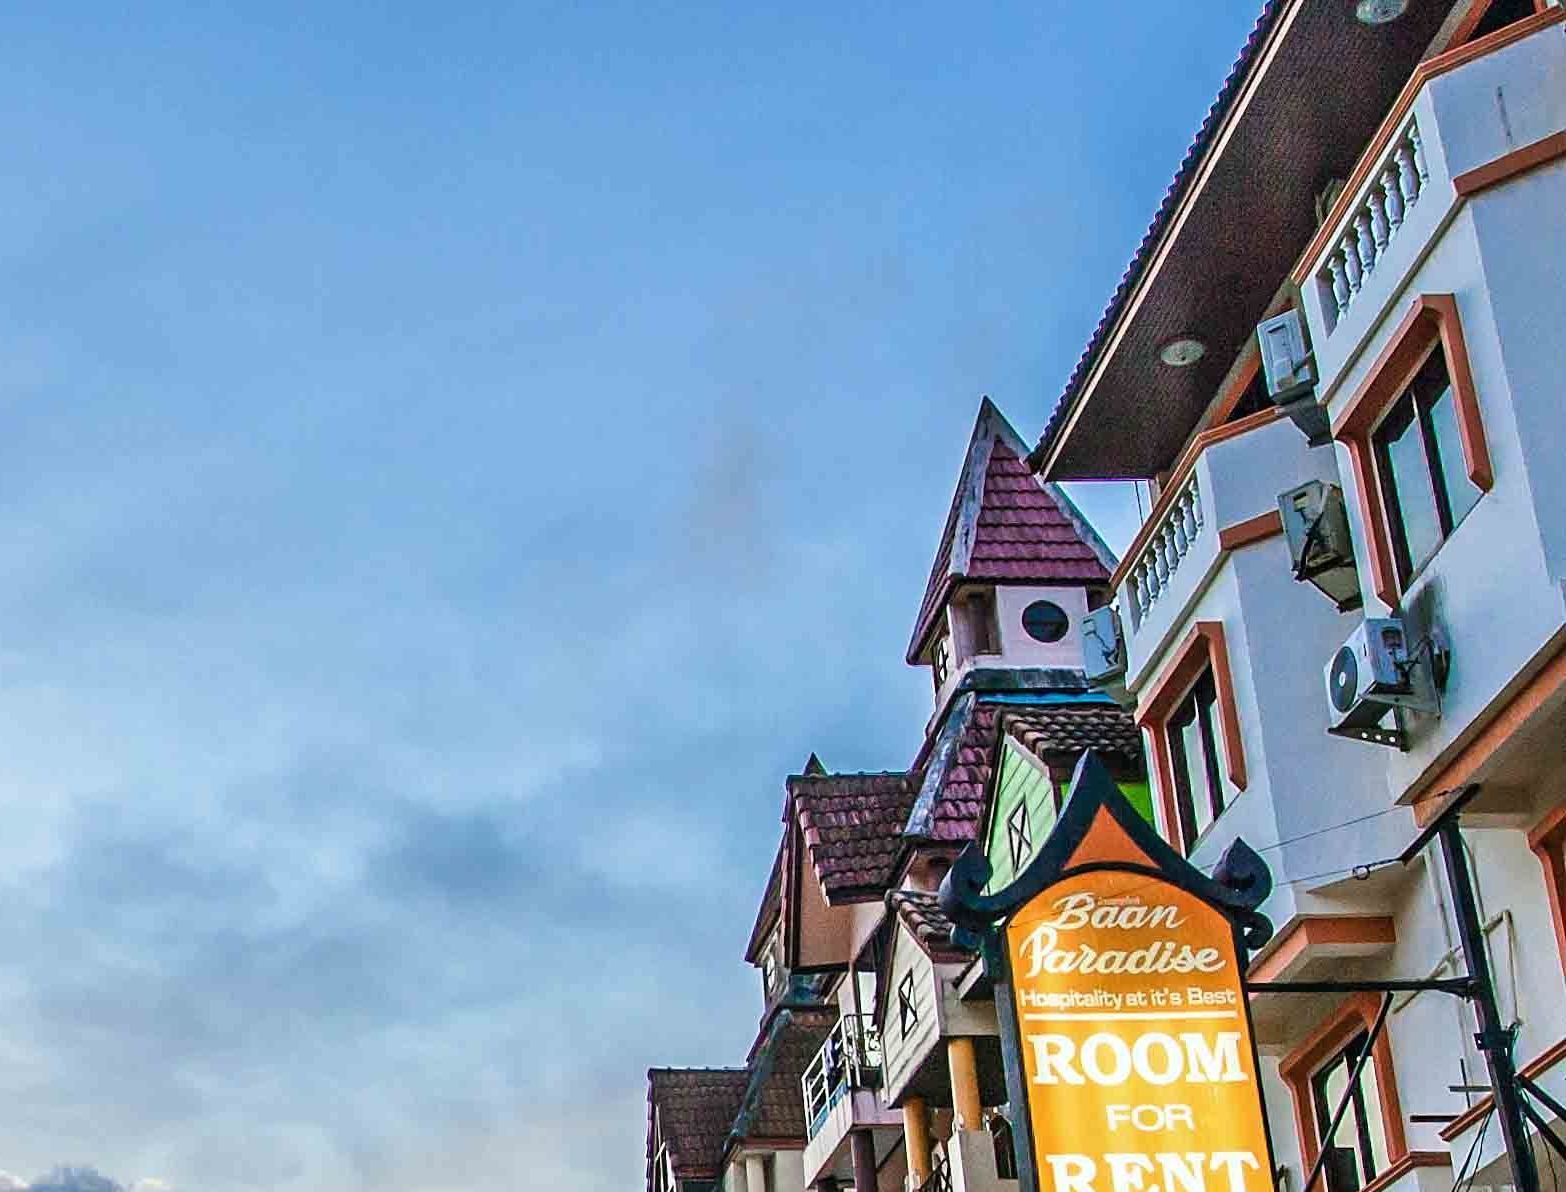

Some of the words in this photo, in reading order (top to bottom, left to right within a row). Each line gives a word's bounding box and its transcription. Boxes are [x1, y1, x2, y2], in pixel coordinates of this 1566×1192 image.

[1042, 892, 1188, 929] Baan
[1019, 926, 1226, 978] Paradise
[1020, 989, 1123, 1010] Hospitality
[1126, 991, 1146, 1006] at
[1151, 988, 1183, 1006] it's
[1186, 987, 1237, 1005] Best
[1027, 1032, 1248, 1086] ROOM
[1106, 1105, 1195, 1133] FOR
